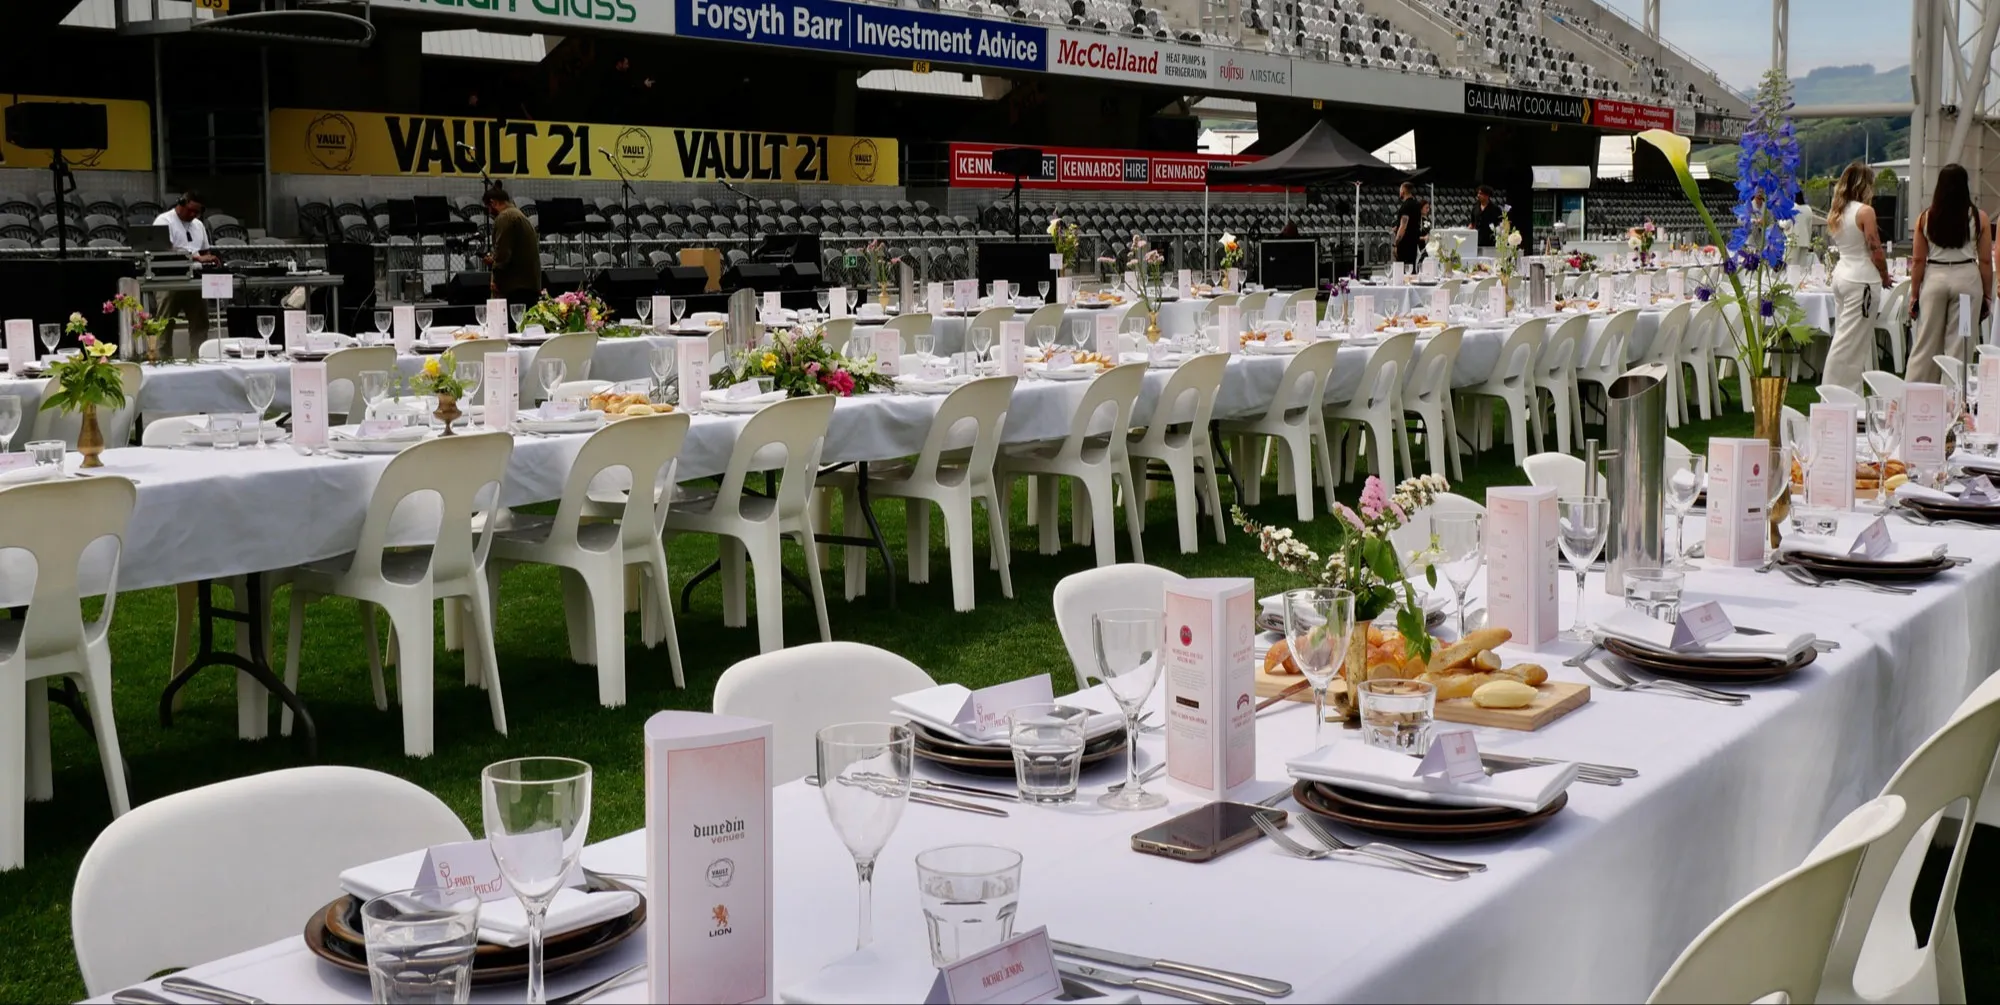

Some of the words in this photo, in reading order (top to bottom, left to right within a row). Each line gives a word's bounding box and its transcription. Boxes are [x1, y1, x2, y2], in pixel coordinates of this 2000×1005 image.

[692, 0, 784, 39] Forsyth
[793, 6, 843, 41] Barr
[857, 15, 971, 54] Investment
[978, 29, 1038, 62] Advice
[1057, 39, 1159, 75] McClelland
[1165, 53, 1180, 63] HEAT
[1182, 54, 1200, 65] PUMPS
[1201, 56, 1206, 66] &
[915, 61, 927, 73] 06
[1164, 65, 1207, 79] REFRIGERATION
[1220, 62, 1244, 82] FUJITSU
[1250, 69, 1286, 85] AIRSTAGE
[1467, 89, 1522, 112] GALLAWAY
[1524, 94, 1552, 115] COOK
[1553, 98, 1582, 118] ALLAN
[316, 133, 346, 144] VAULT
[385, 115, 537, 175] VAULT
[547, 124, 592, 176] 21
[622, 145, 645, 155] VAULT
[674, 129, 789, 180] VAULT
[795, 135, 830, 182] 21
[855, 154, 872, 163] VAULT
[959, 157, 1006, 175] KENN
[1042, 161, 1055, 176] RE
[1063, 160, 1121, 178] KENNARDS
[1125, 165, 1147, 180] HIRE
[1155, 166, 1206, 180] KENNARDS
[693, 816, 745, 838] dunedin
[711, 832, 745, 844] venues
[711, 868, 729, 877] VAULT
[709, 927, 732, 938] LION
